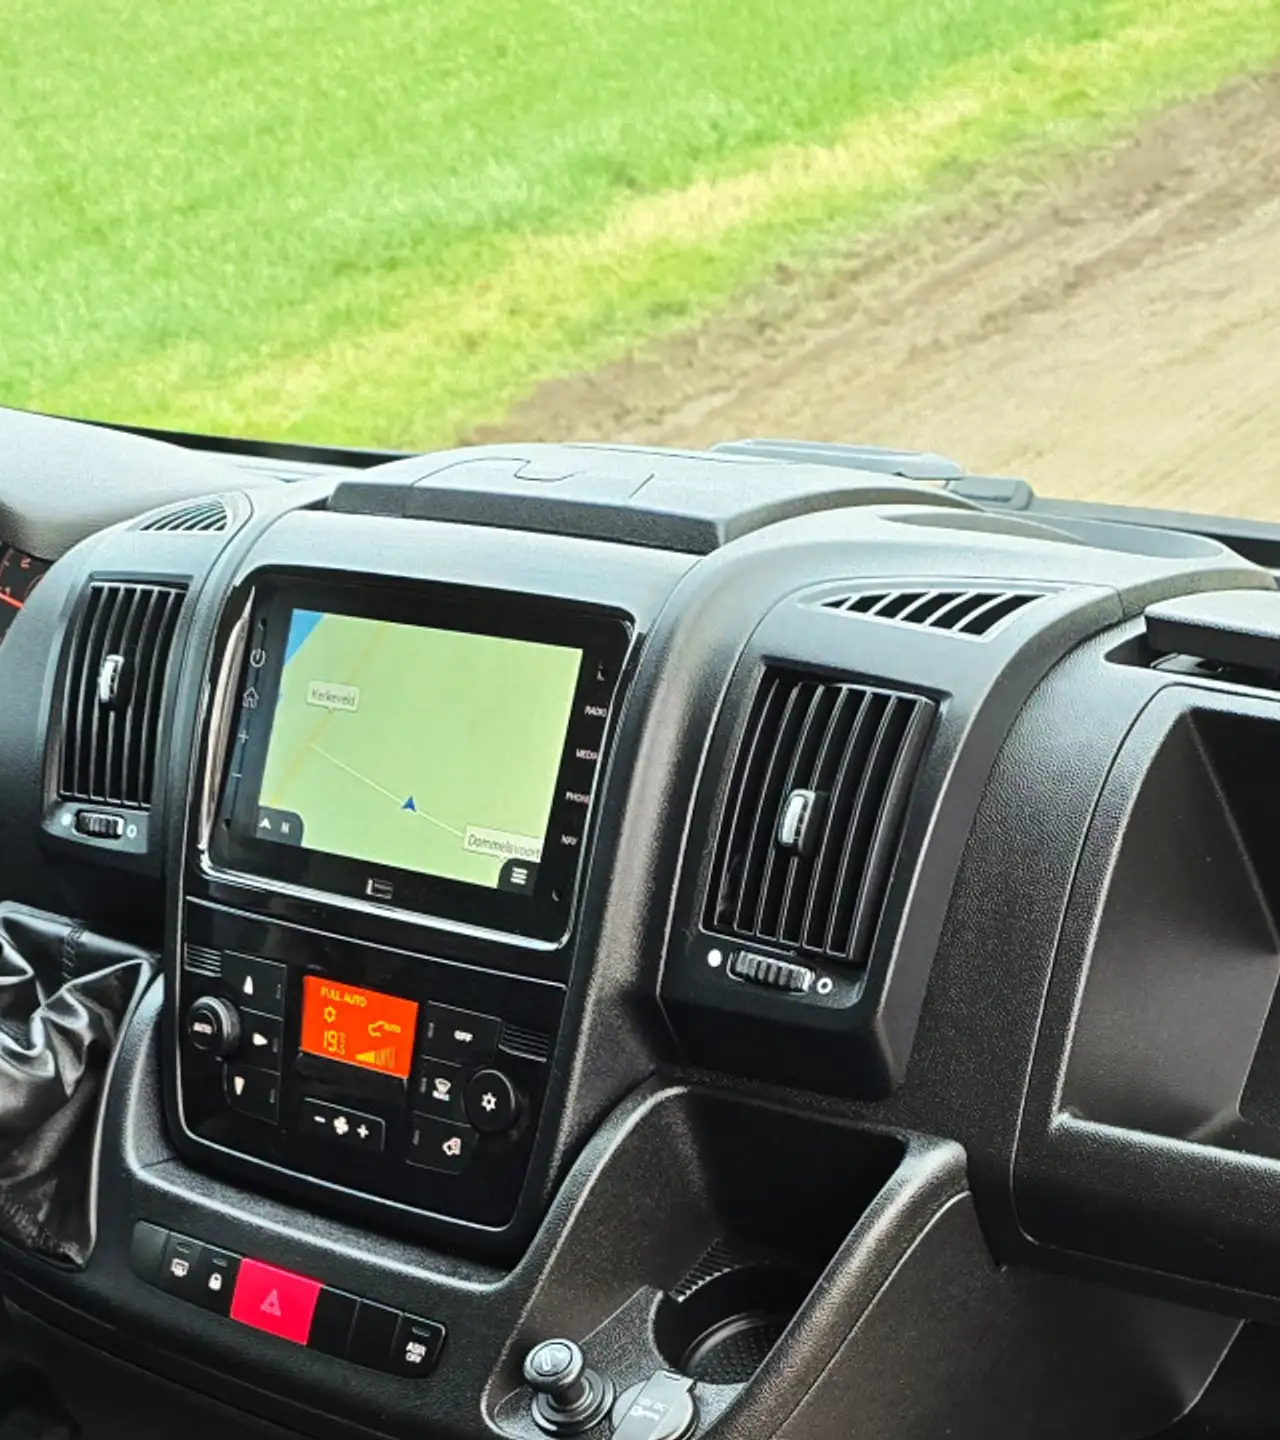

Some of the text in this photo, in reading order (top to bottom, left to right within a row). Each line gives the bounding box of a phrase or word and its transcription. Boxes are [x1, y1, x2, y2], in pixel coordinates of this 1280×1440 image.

[584, 704, 607, 718] RADIO
[320, 984, 368, 1008] FULL AUTO
